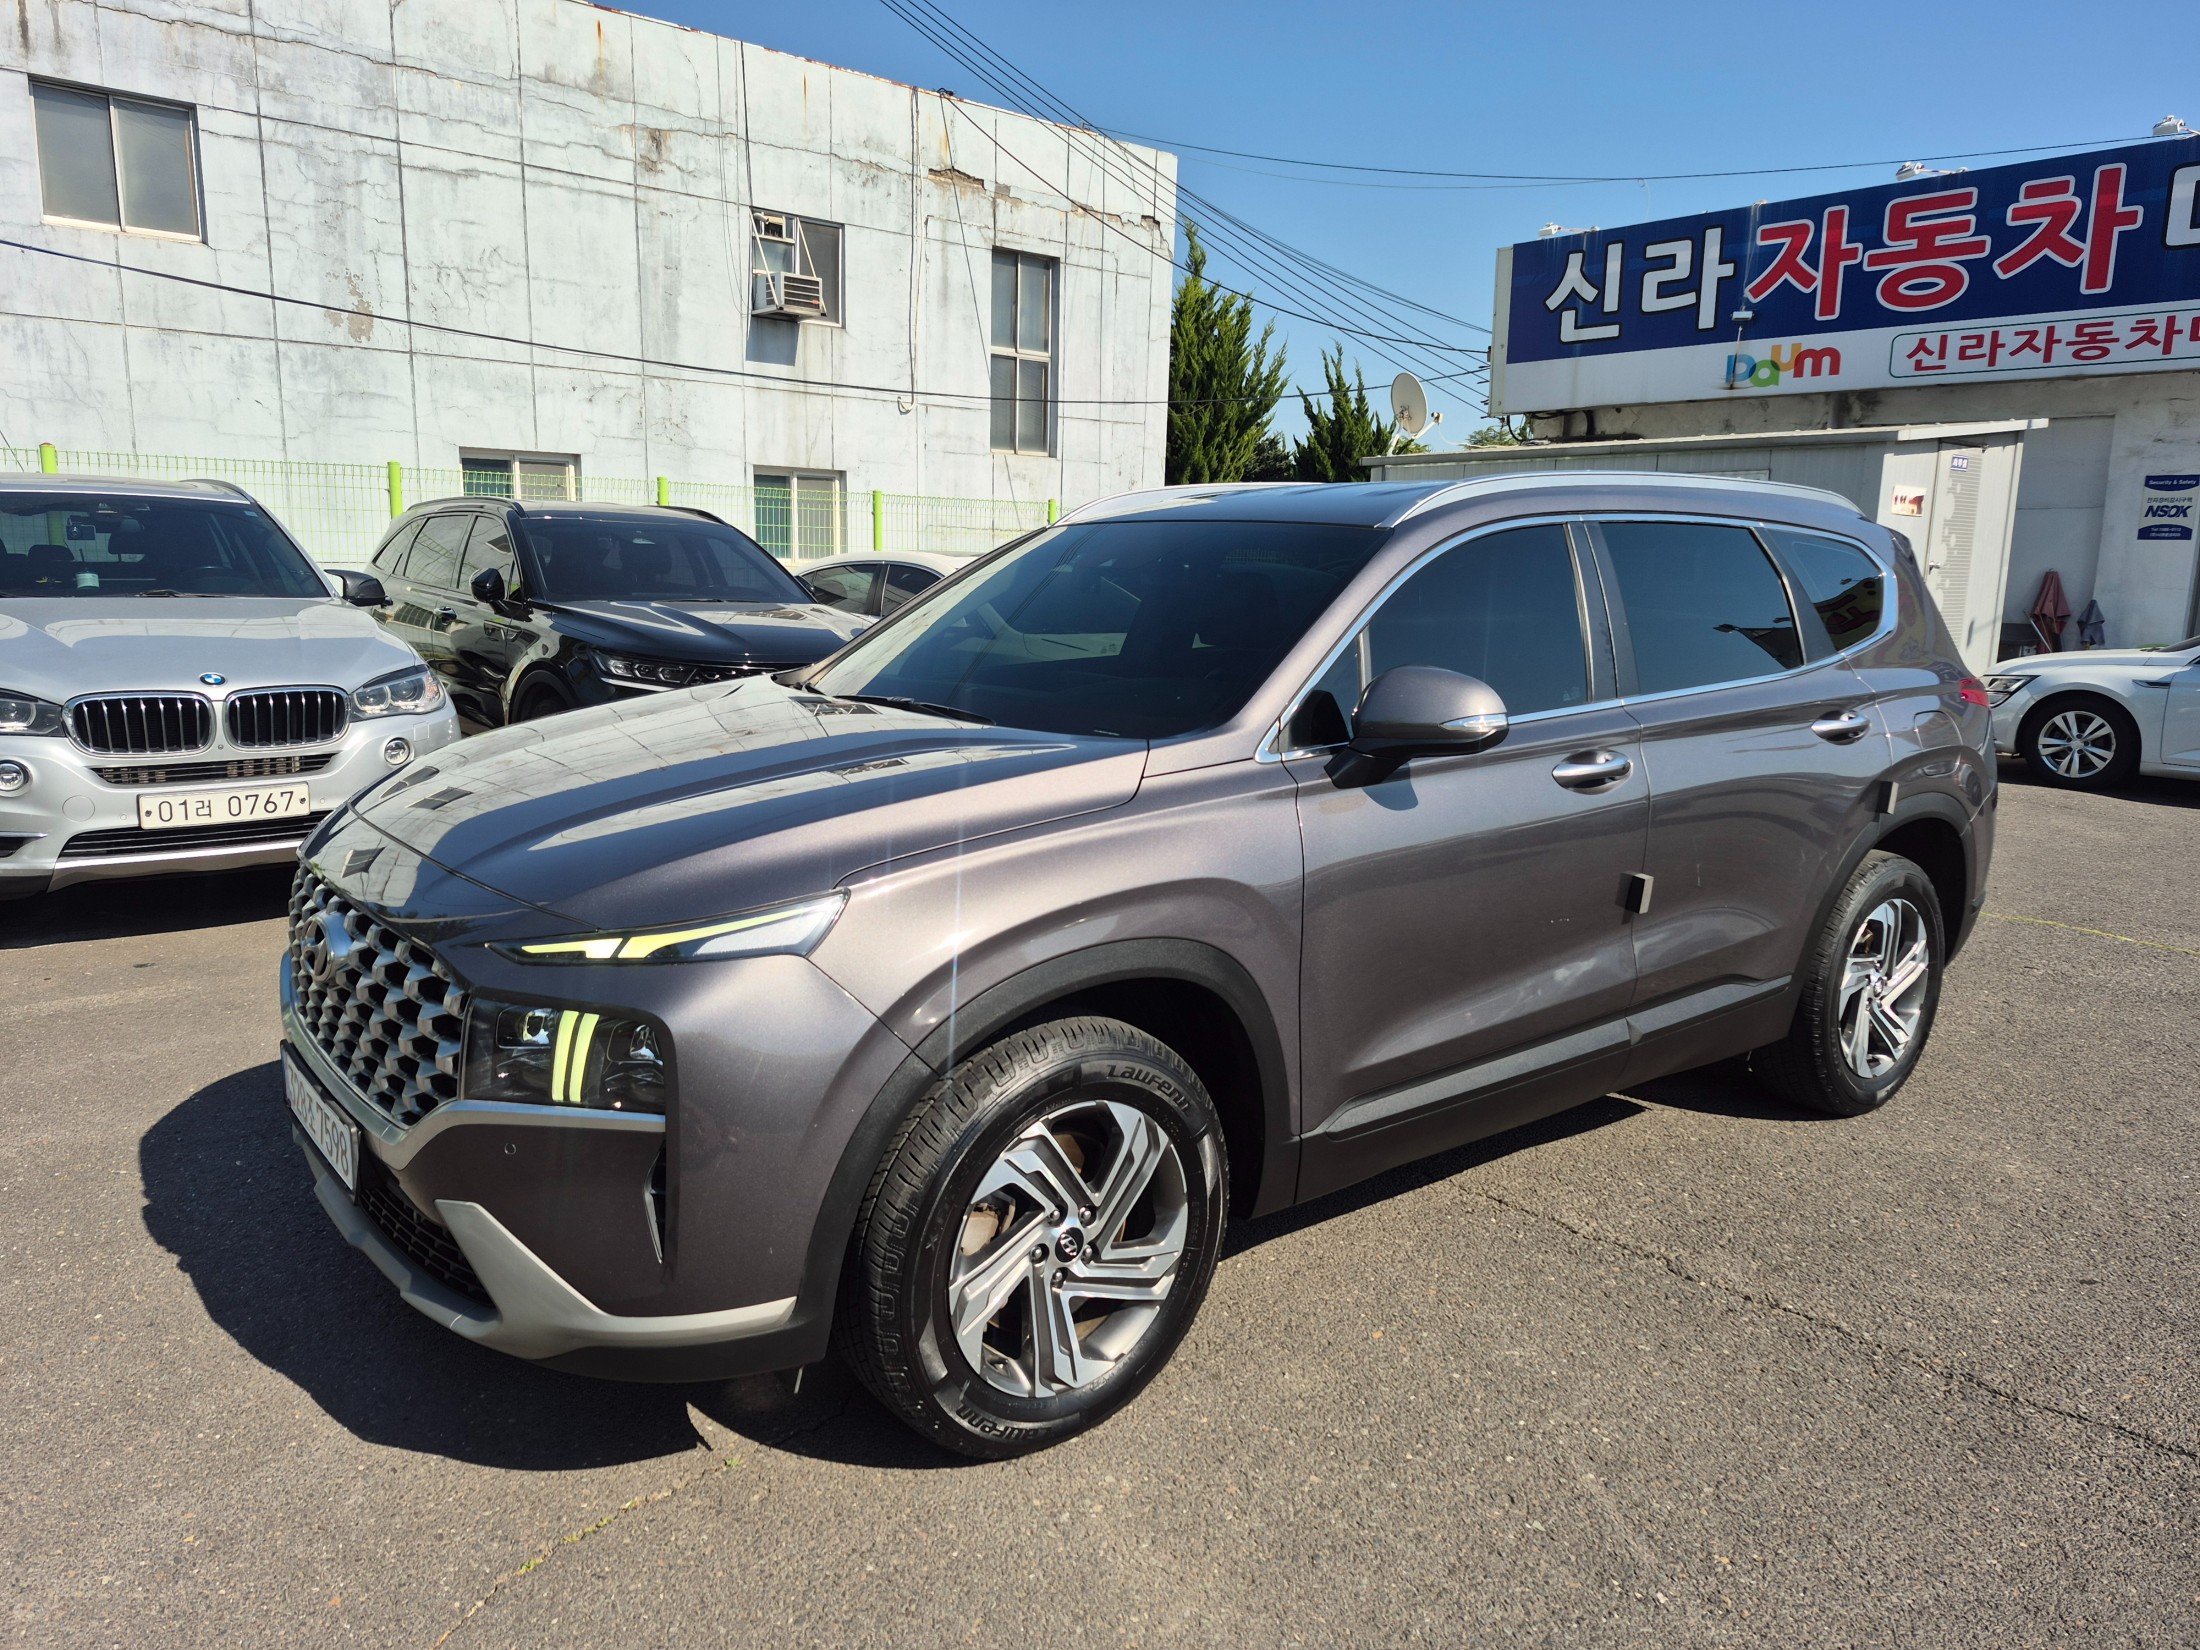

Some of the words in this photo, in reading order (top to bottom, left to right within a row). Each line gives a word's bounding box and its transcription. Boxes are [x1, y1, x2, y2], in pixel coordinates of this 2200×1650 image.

[1545, 163, 2200, 343] 신라자동차
[1906, 315, 2200, 372] 신라자동차
[2144, 505, 2193, 518] NSOK
[158, 799, 212, 823] 01러
[228, 791, 294, 817] 0767
[316, 1102, 349, 1177] 7598
